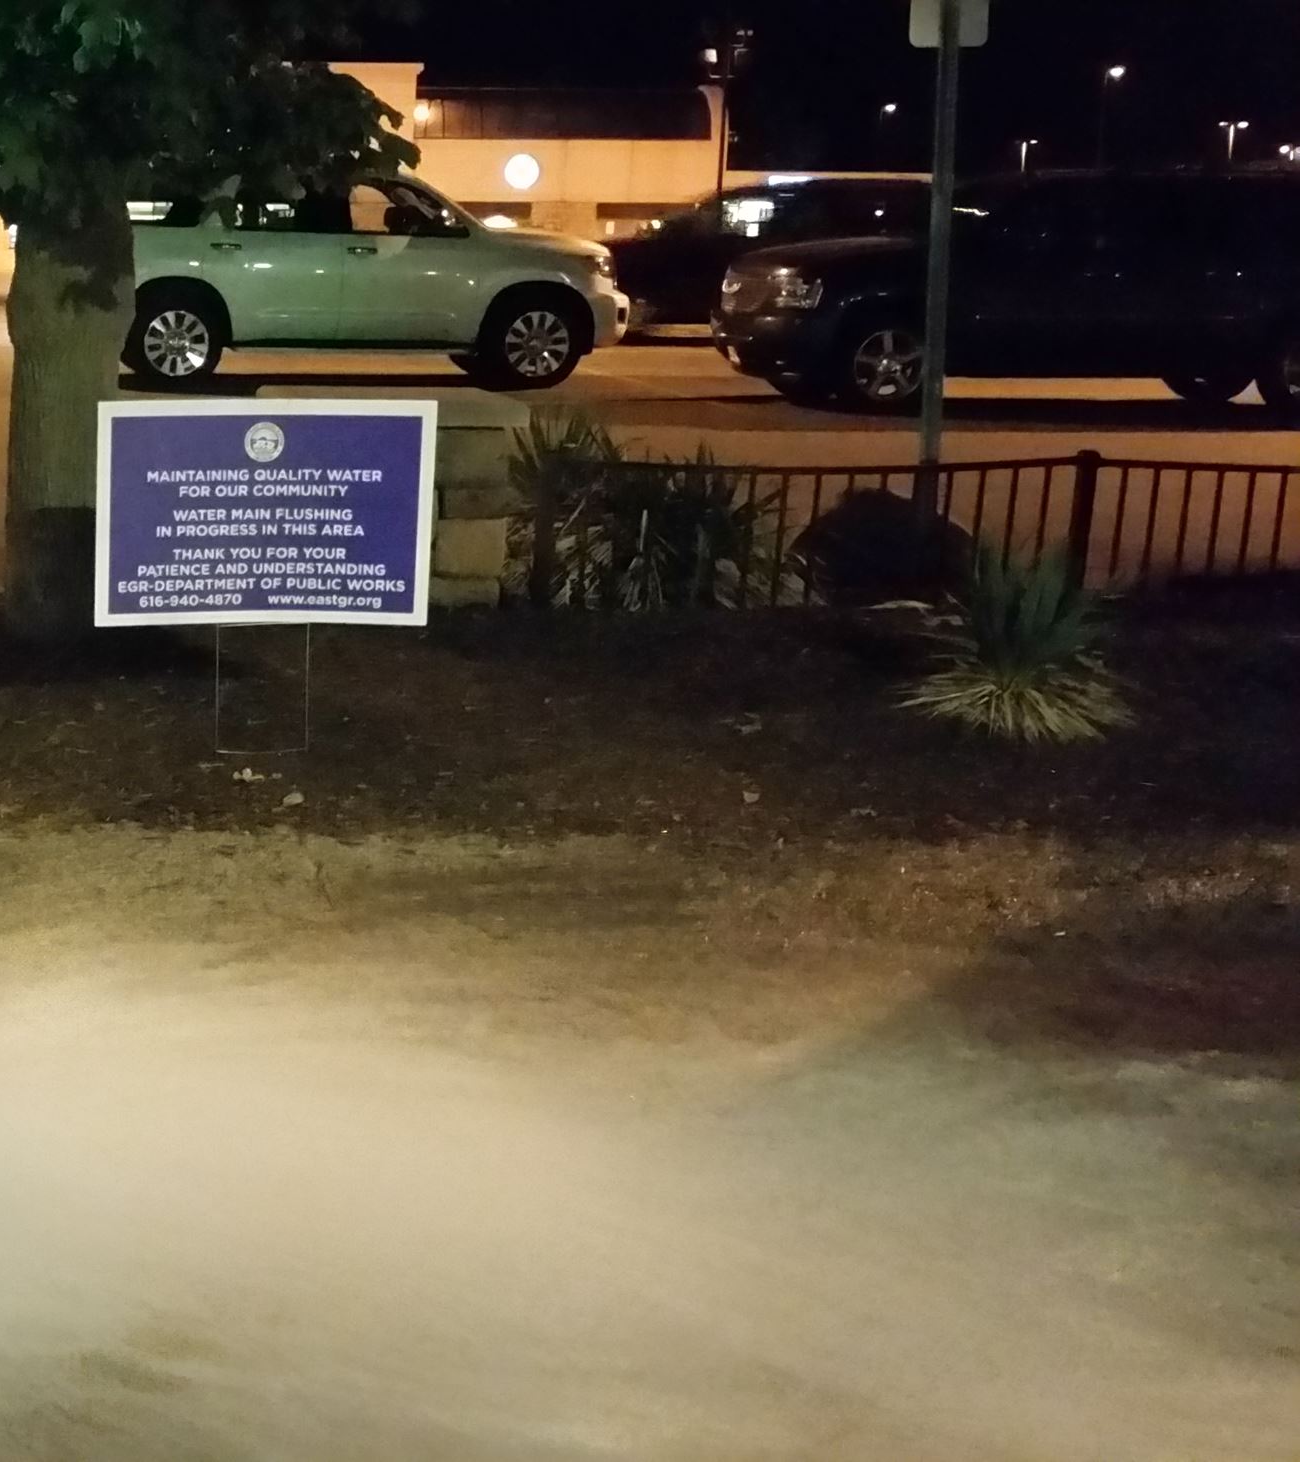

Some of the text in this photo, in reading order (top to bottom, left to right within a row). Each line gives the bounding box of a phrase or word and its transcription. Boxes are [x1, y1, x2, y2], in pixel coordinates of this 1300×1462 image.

[147, 469, 382, 483] MAINTAINING QUALITY WATER
[179, 485, 348, 498] FOR OUR COMMUNITY
[173, 509, 353, 522] WATER MAIN FLUSHING
[156, 524, 365, 537] IN PROGRESS IN THIS AREA
[173, 548, 345, 561] THANK YOU FOR YOUR
[138, 563, 386, 578] PATIENCE AND UNDERSTANDING
[118, 578, 405, 593] EGR-DEPARTMENT OF PUBLIC WORKS
[139, 594, 382, 609] 616-940-4870 www.eastgr.org
